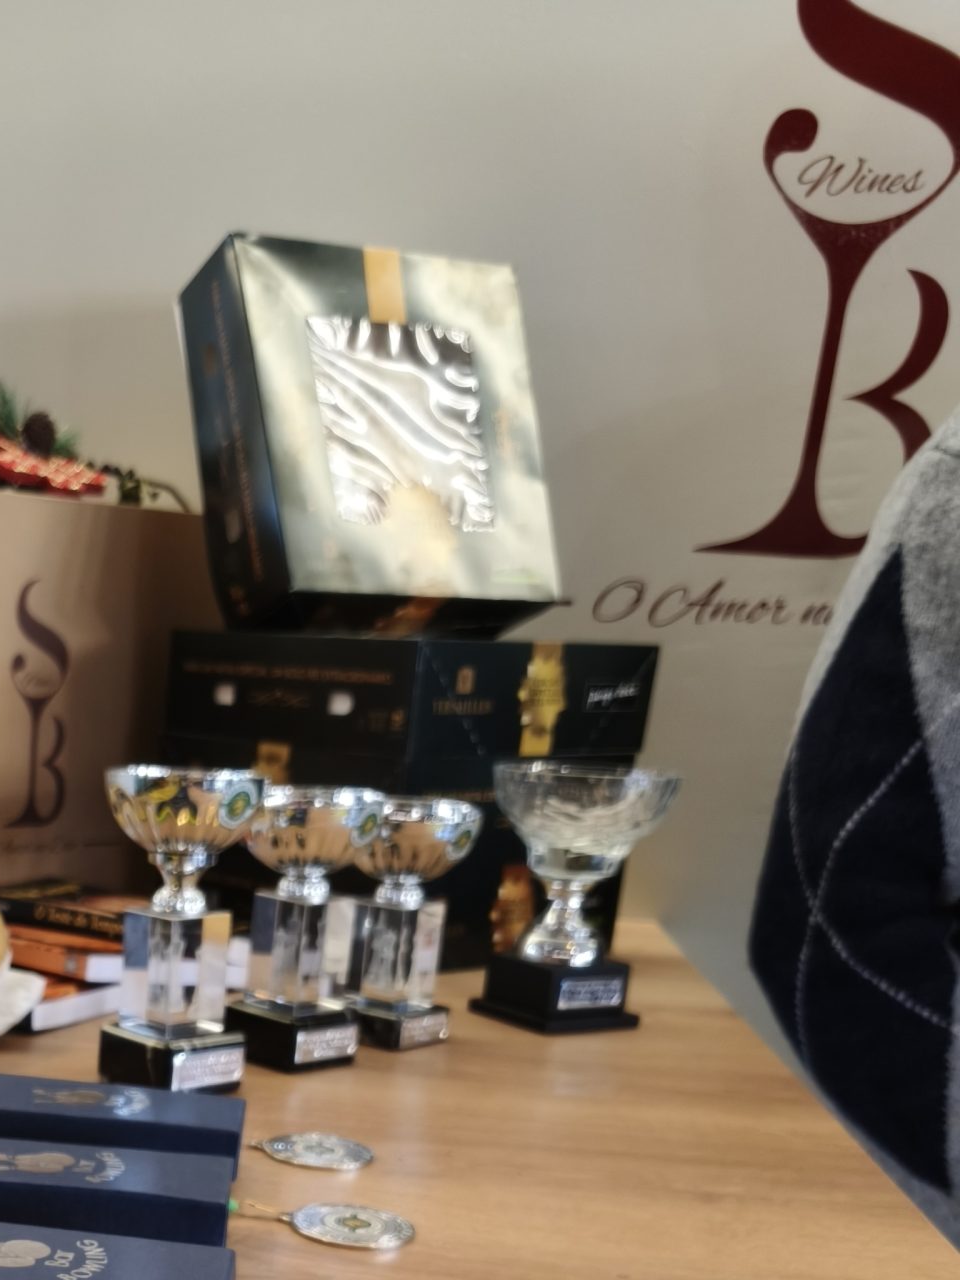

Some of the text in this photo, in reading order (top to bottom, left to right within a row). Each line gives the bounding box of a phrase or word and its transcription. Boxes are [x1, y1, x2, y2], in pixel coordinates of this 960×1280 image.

[797, 154, 925, 199] Wines
[592, 578, 646, 624] O
[648, 578, 790, 629] Amor
[48, 1249, 76, 1268] Bar
